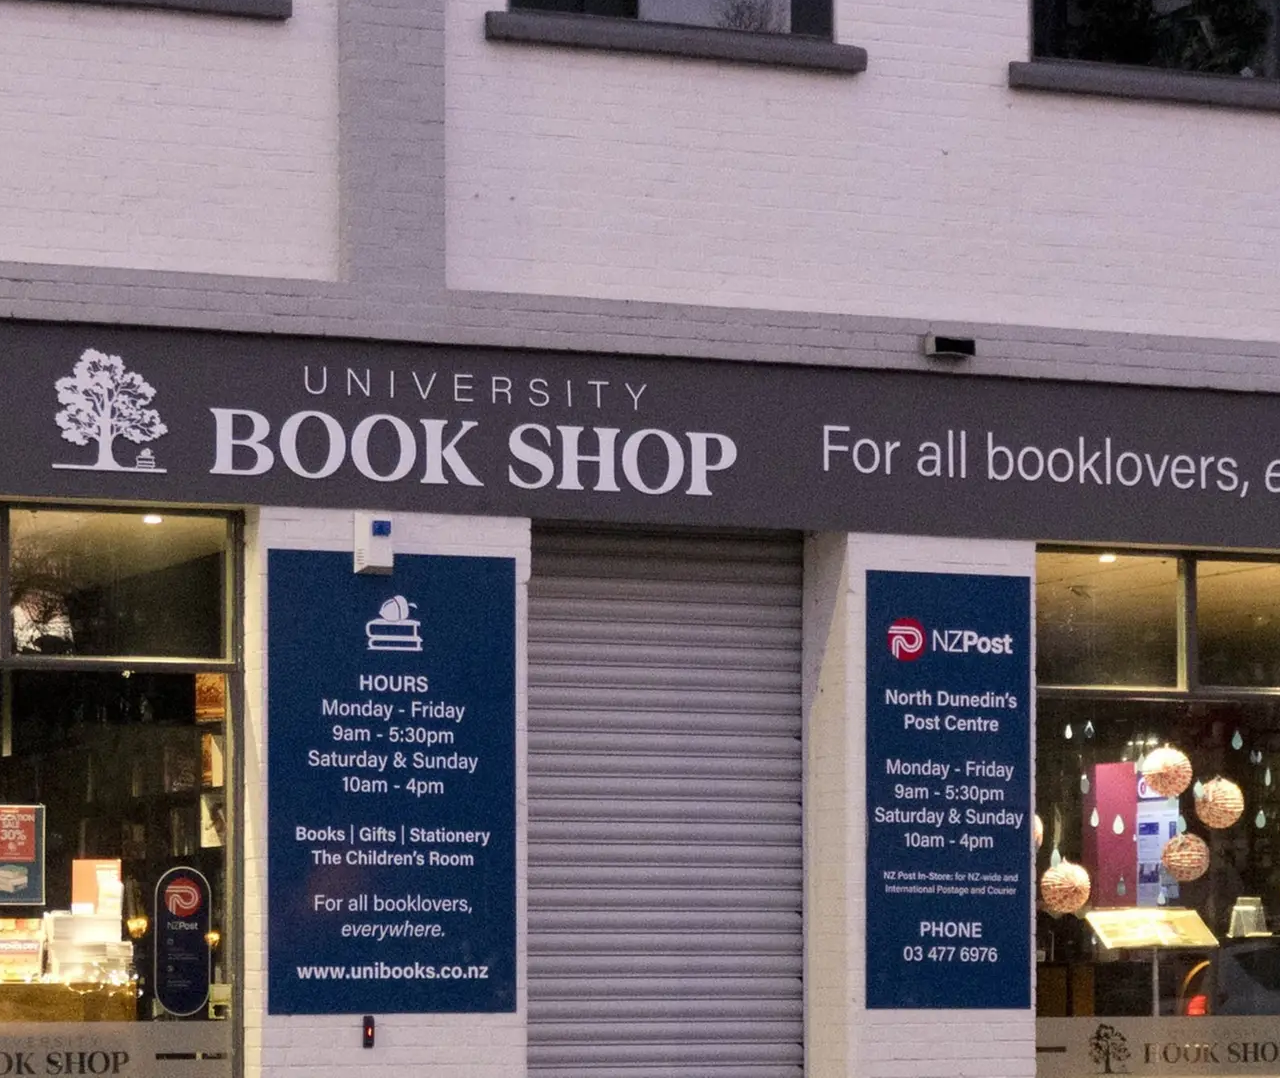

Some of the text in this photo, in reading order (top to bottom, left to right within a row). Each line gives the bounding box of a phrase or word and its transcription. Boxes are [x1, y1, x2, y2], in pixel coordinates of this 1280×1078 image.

[304, 364, 649, 411] UNIVERSITY
[209, 407, 738, 496] BOOK SHOP
[821, 424, 901, 475] For
[917, 429, 968, 479] all
[987, 432, 1249, 498] booklovers,
[932, 629, 1013, 655] NZPost
[359, 675, 429, 693] HOURS
[885, 689, 1018, 708] North Dunedin's
[322, 699, 393, 721] Monday
[411, 701, 465, 723] Friday
[904, 714, 999, 732] Post Centre
[332, 725, 370, 742] 9am
[389, 727, 454, 746] 5:30pm
[308, 750, 478, 773] Saturday & Sunday
[886, 758, 950, 780] Monday
[965, 761, 1014, 781] Friday
[342, 776, 388, 793] 10am
[406, 778, 444, 797] 4pm
[894, 784, 929, 799] 9am
[945, 785, 1005, 804] 5:30pm
[874, 807, 1023, 830] Saturday & Sunday
[0, 829, 26, 840] 30%
[295, 826, 345, 842] Books
[359, 827, 396, 842] Gifts
[410, 828, 490, 847] Stationery
[904, 833, 945, 848] 10am
[959, 834, 994, 851] 4pm
[311, 850, 474, 866] The Children's Room
[883, 871, 896, 880] NZ
[898, 871, 916, 880] Post
[955, 872, 966, 881] for
[1003, 873, 1019, 882] and
[885, 884, 1016, 896] International Postage and Courier
[314, 894, 473, 914] For all booklovers,
[341, 920, 446, 941] everywhere.
[920, 922, 983, 938] PHONE
[903, 946, 998, 962] 03 477 6976
[296, 962, 489, 979] www.unibooks.co.nz
[46, 1051, 129, 1075] SHOP
